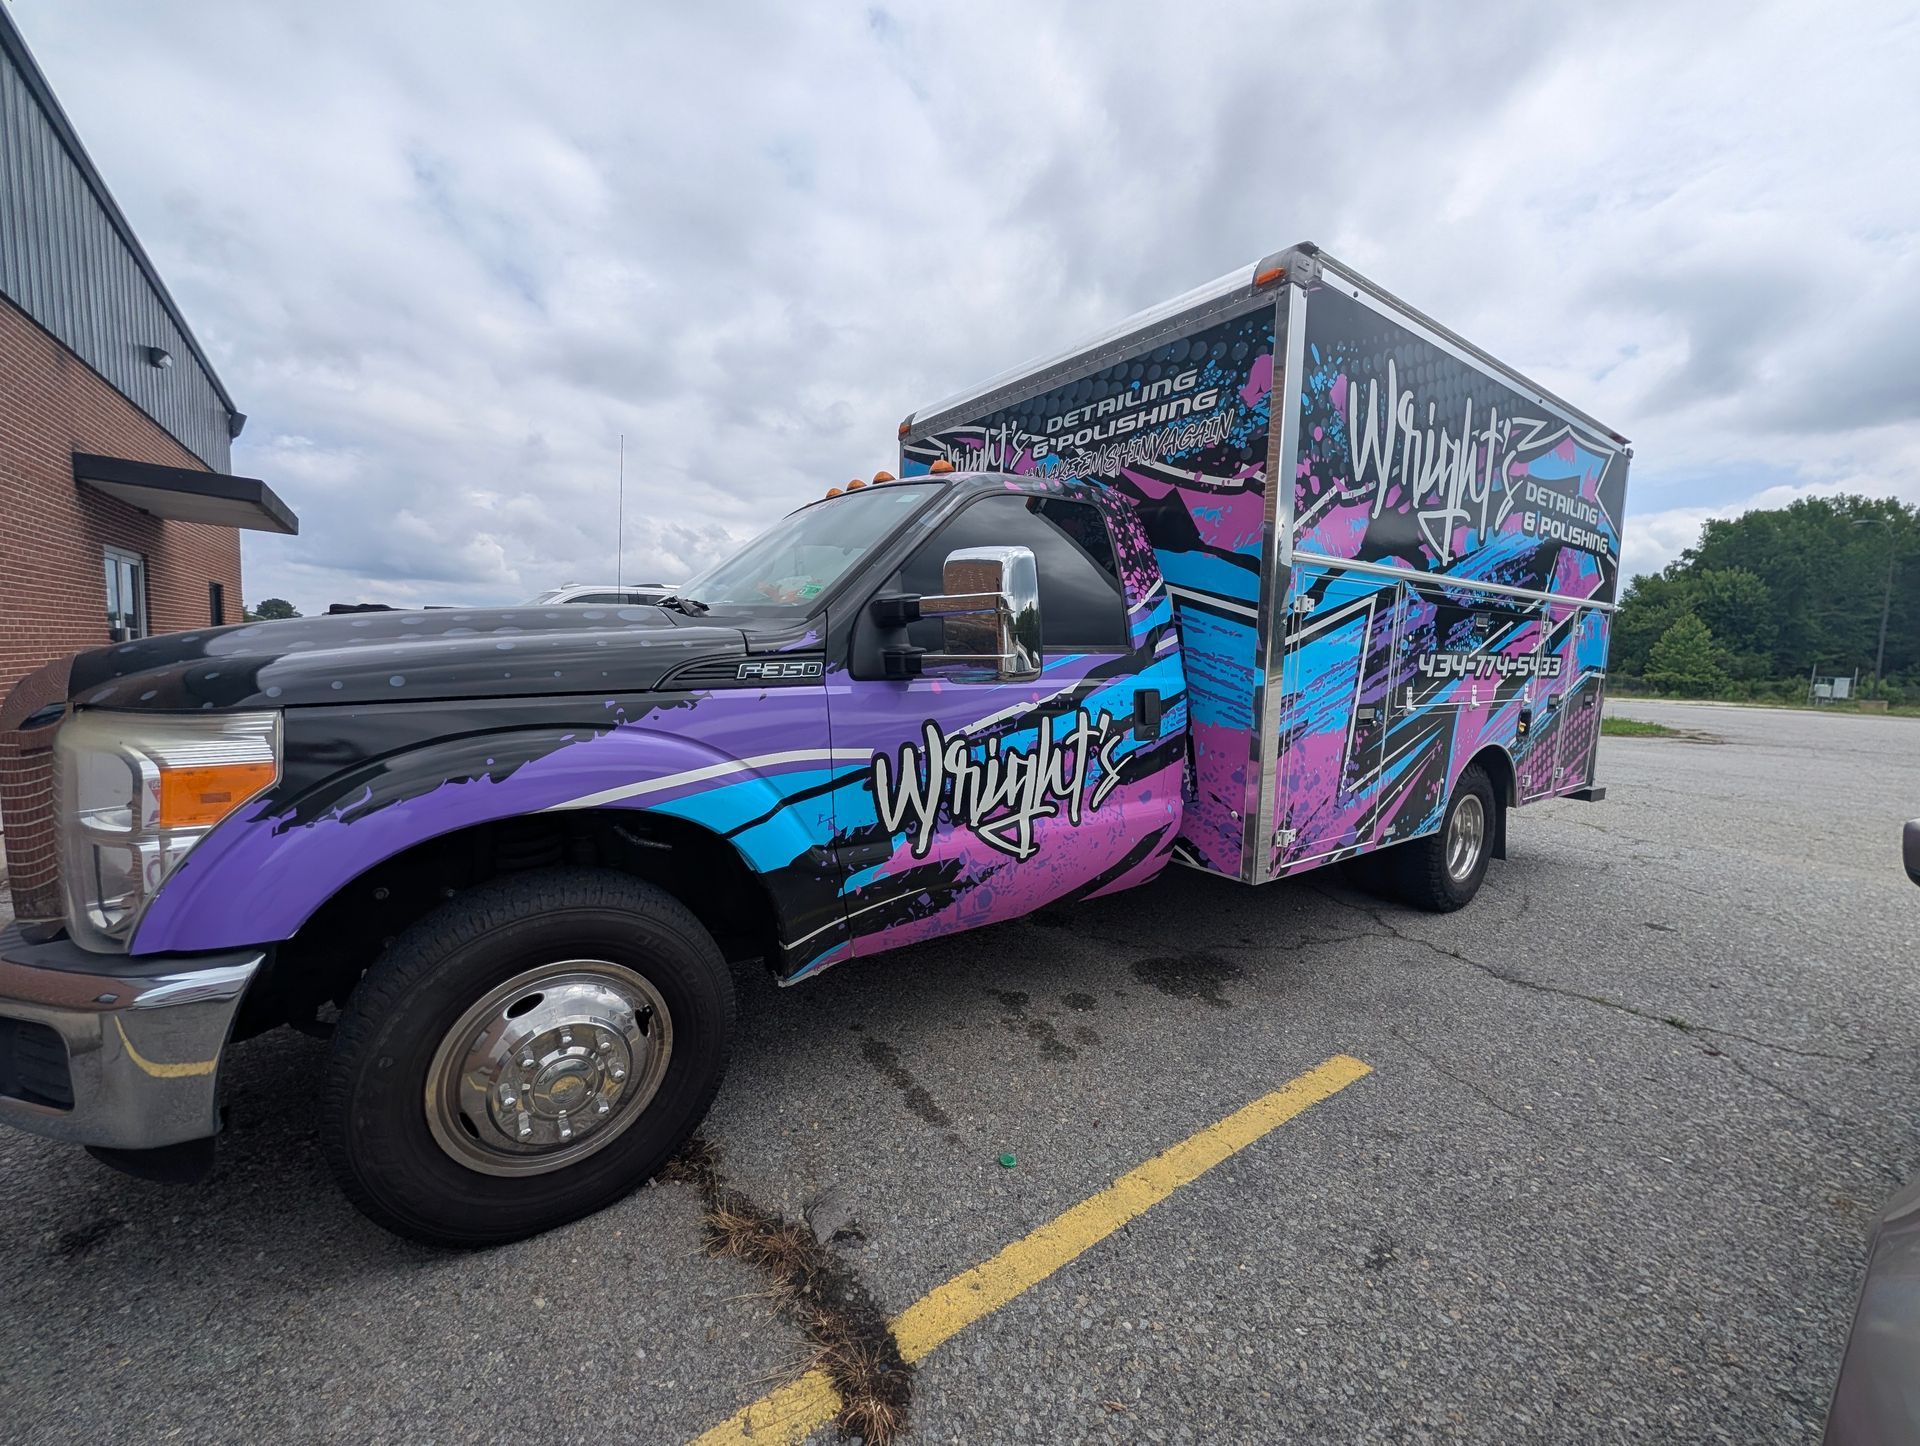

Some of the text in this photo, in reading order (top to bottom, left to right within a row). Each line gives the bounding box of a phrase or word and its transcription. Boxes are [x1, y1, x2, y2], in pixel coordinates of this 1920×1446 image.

[1032, 387, 1219, 459] & POLISHING
[1047, 368, 1199, 434] DETAILING
[940, 420, 1032, 473] right's
[1350, 358, 1524, 565] Wright's
[1525, 481, 1599, 526] DETAILING
[1523, 511, 1610, 555] & POLISHING
[736, 661, 824, 679] F-350
[1418, 653, 1562, 678] 434-774-5433
[873, 711, 1133, 859] Wright's
